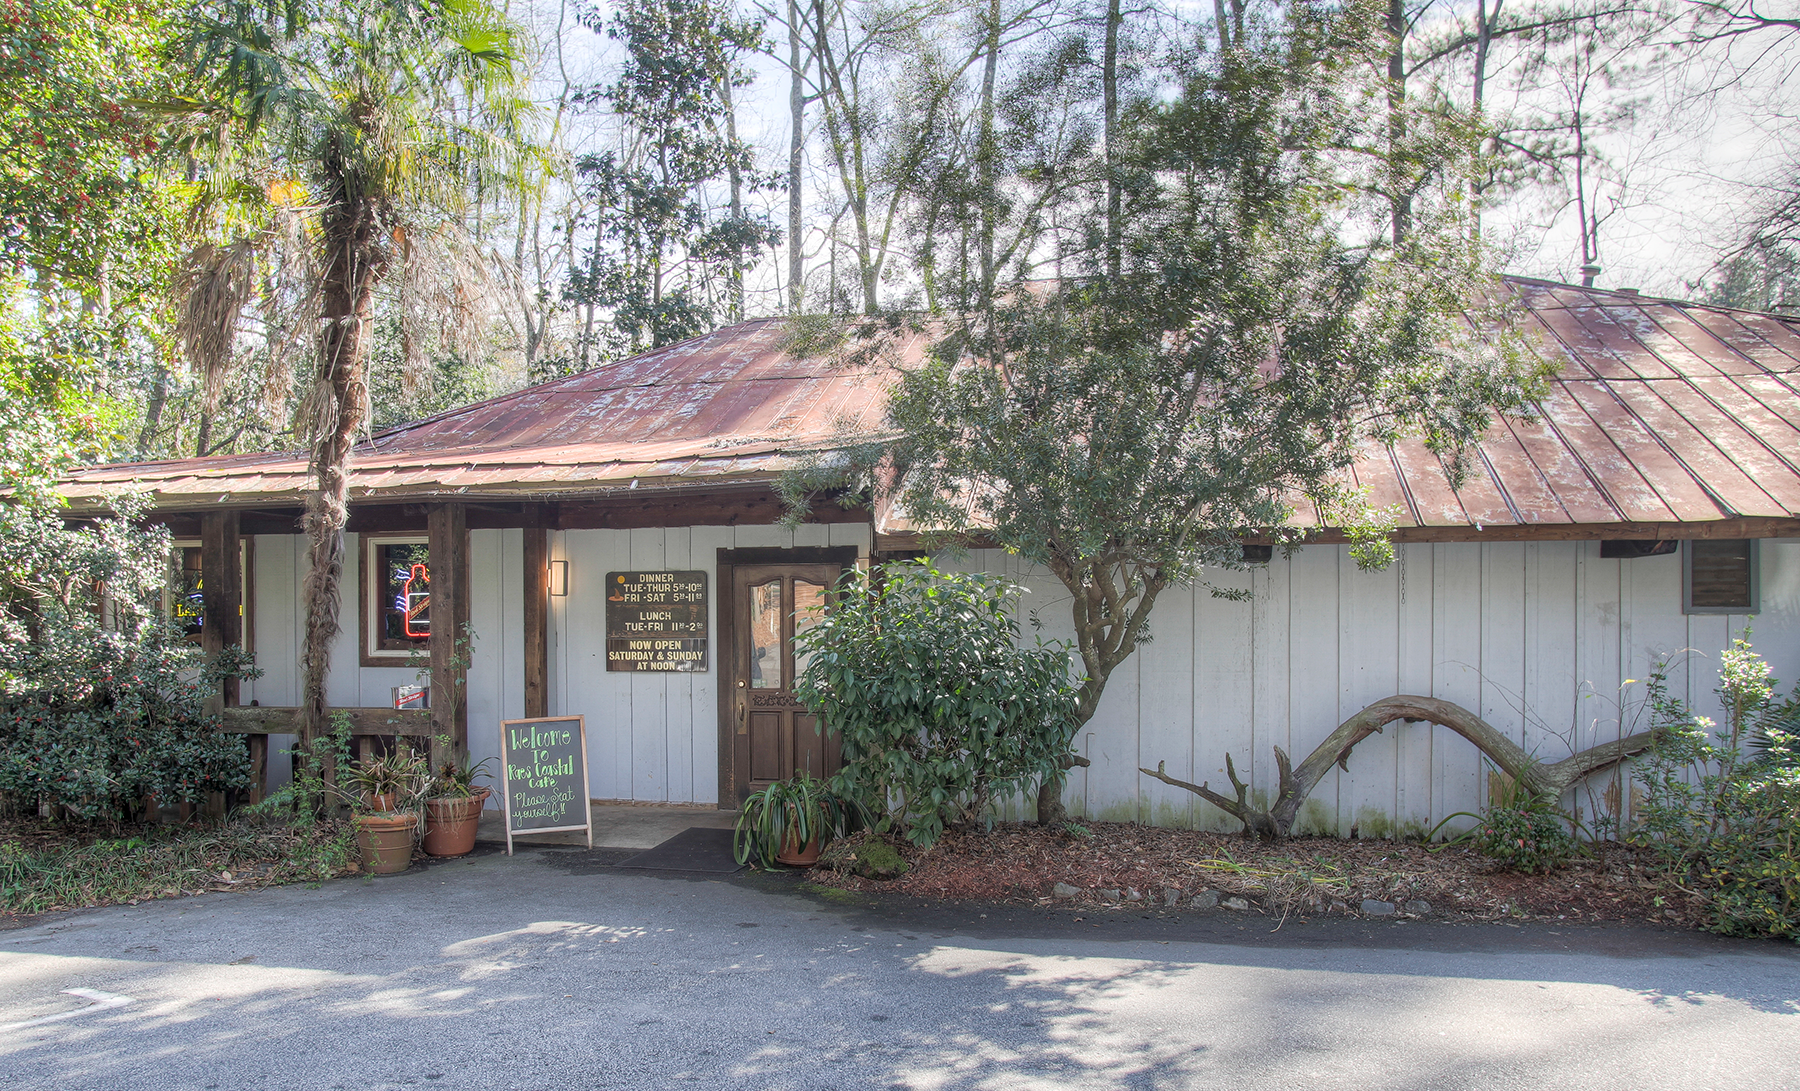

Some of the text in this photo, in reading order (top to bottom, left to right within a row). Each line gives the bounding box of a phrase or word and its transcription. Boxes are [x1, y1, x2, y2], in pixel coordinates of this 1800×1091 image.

[639, 574, 674, 583] DINNER
[623, 583, 671, 593] TUE-THUR
[624, 593, 640, 602] FRI
[639, 612, 672, 621] LUNCH
[625, 622, 664, 631] TUE-FRI
[629, 640, 681, 650] NOW OPEN
[608, 651, 703, 661] SATURDAY & SUNDAY
[636, 661, 676, 670] AT NOON
[511, 727, 571, 750] Welcome
[535, 755, 574, 777] Coastal
[513, 785, 575, 808] Please Seat
